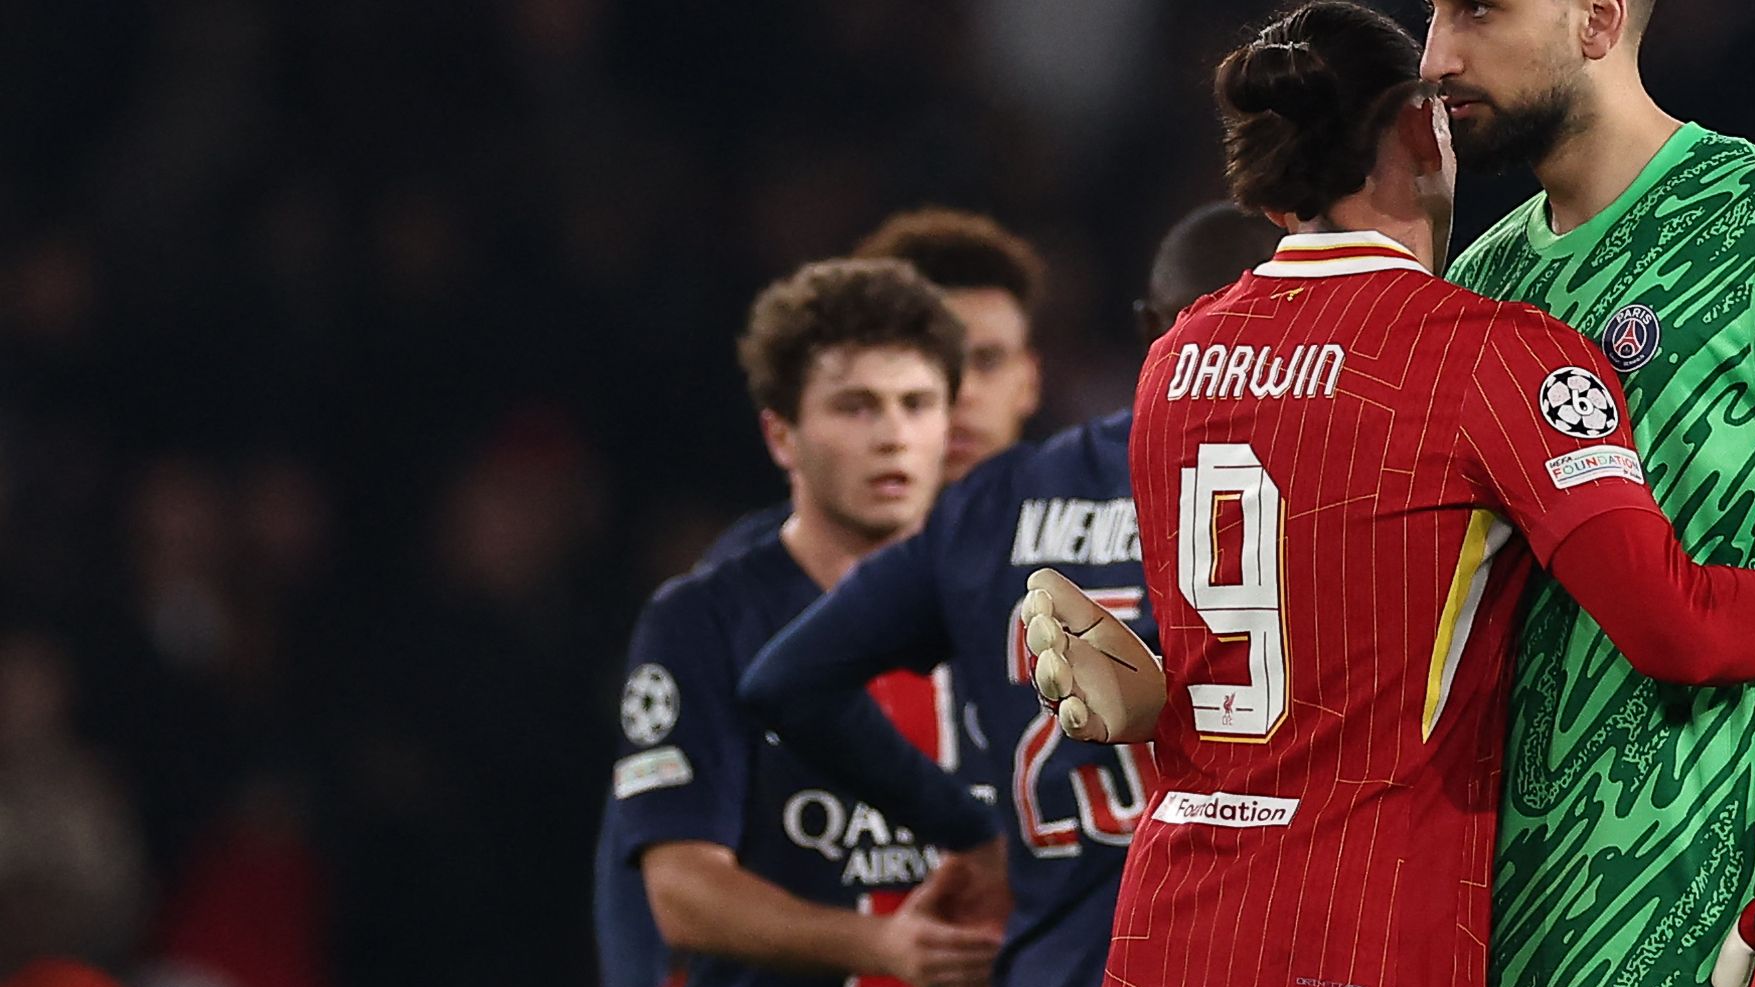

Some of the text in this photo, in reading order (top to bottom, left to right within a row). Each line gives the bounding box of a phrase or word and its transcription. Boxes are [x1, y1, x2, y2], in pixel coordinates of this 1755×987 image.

[1616, 308, 1652, 325] PARIS
[1168, 343, 1346, 401] DARWIN
[1552, 455, 1640, 478] FOUNDATION
[1011, 498, 1142, 565] N.MENDE
[1179, 443, 1290, 744] 9
[1175, 797, 1287, 822] Foundation
